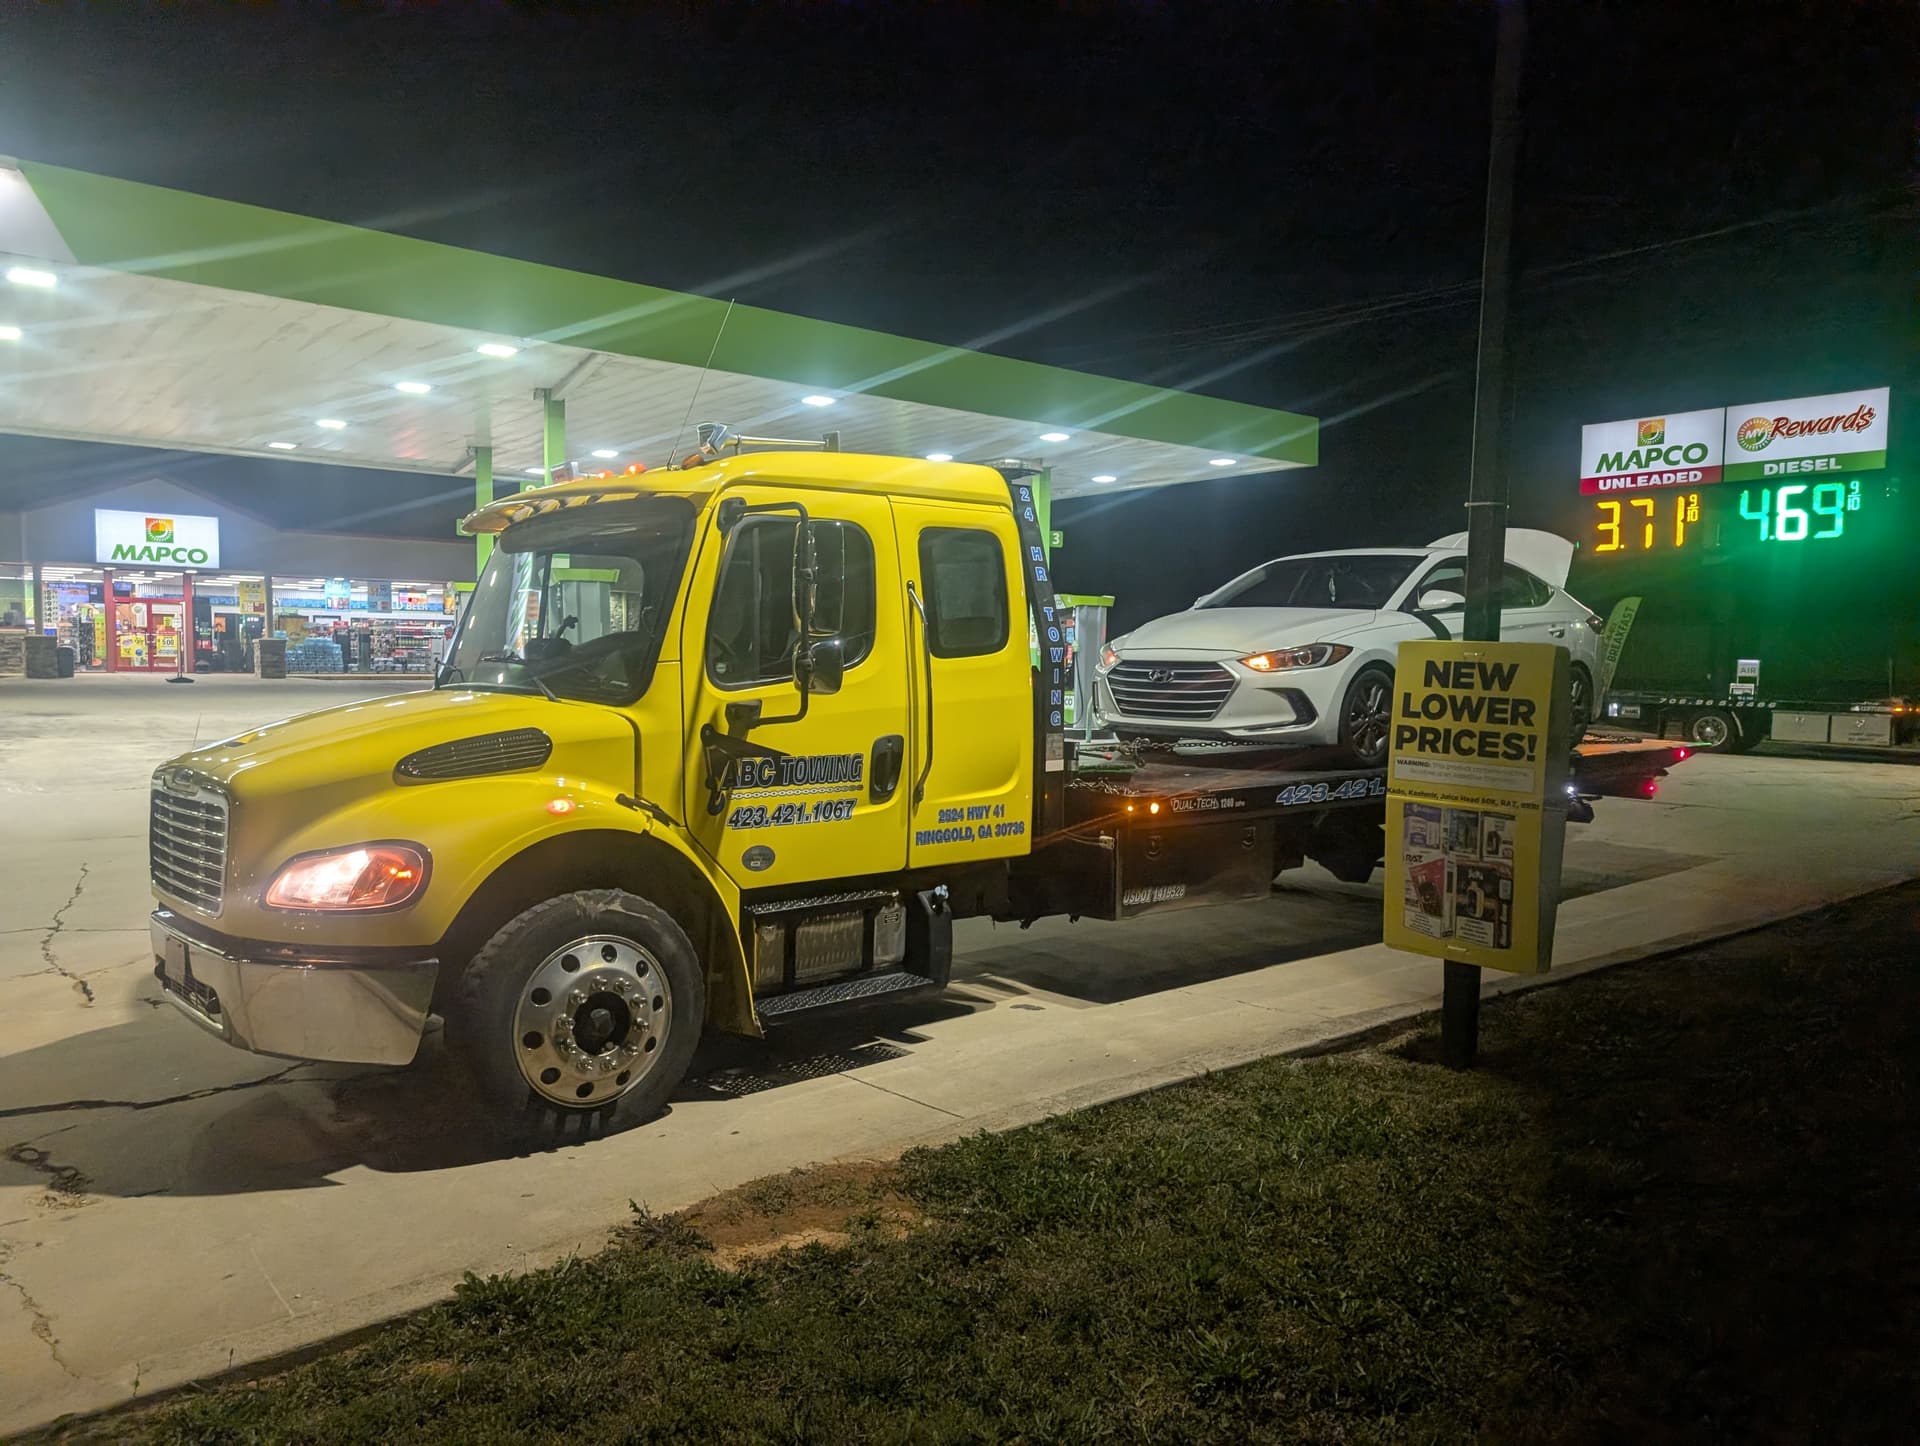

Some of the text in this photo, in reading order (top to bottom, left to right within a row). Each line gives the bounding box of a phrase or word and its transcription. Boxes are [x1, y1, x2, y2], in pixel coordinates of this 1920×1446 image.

[1594, 442, 1709, 474] MAPCO
[1763, 457, 1842, 476] DIESEL
[1598, 470, 1703, 491] UNLEADED
[1595, 494, 1685, 552] 3.71
[1738, 482, 1844, 542] 4.69
[111, 543, 209, 565] MAPCO
[1052, 533, 1060, 545] 3
[1043, 606, 1064, 727] TOWING
[1423, 660, 1519, 691] NEW
[1401, 693, 1537, 727] LOWER
[1395, 725, 1537, 762] PRICES!
[720, 754, 864, 789] ABC TOWING
[727, 798, 858, 831] 423.421.1067
[967, 805, 991, 821] HWY
[993, 804, 1005, 819] 41
[978, 824, 993, 839] GA
